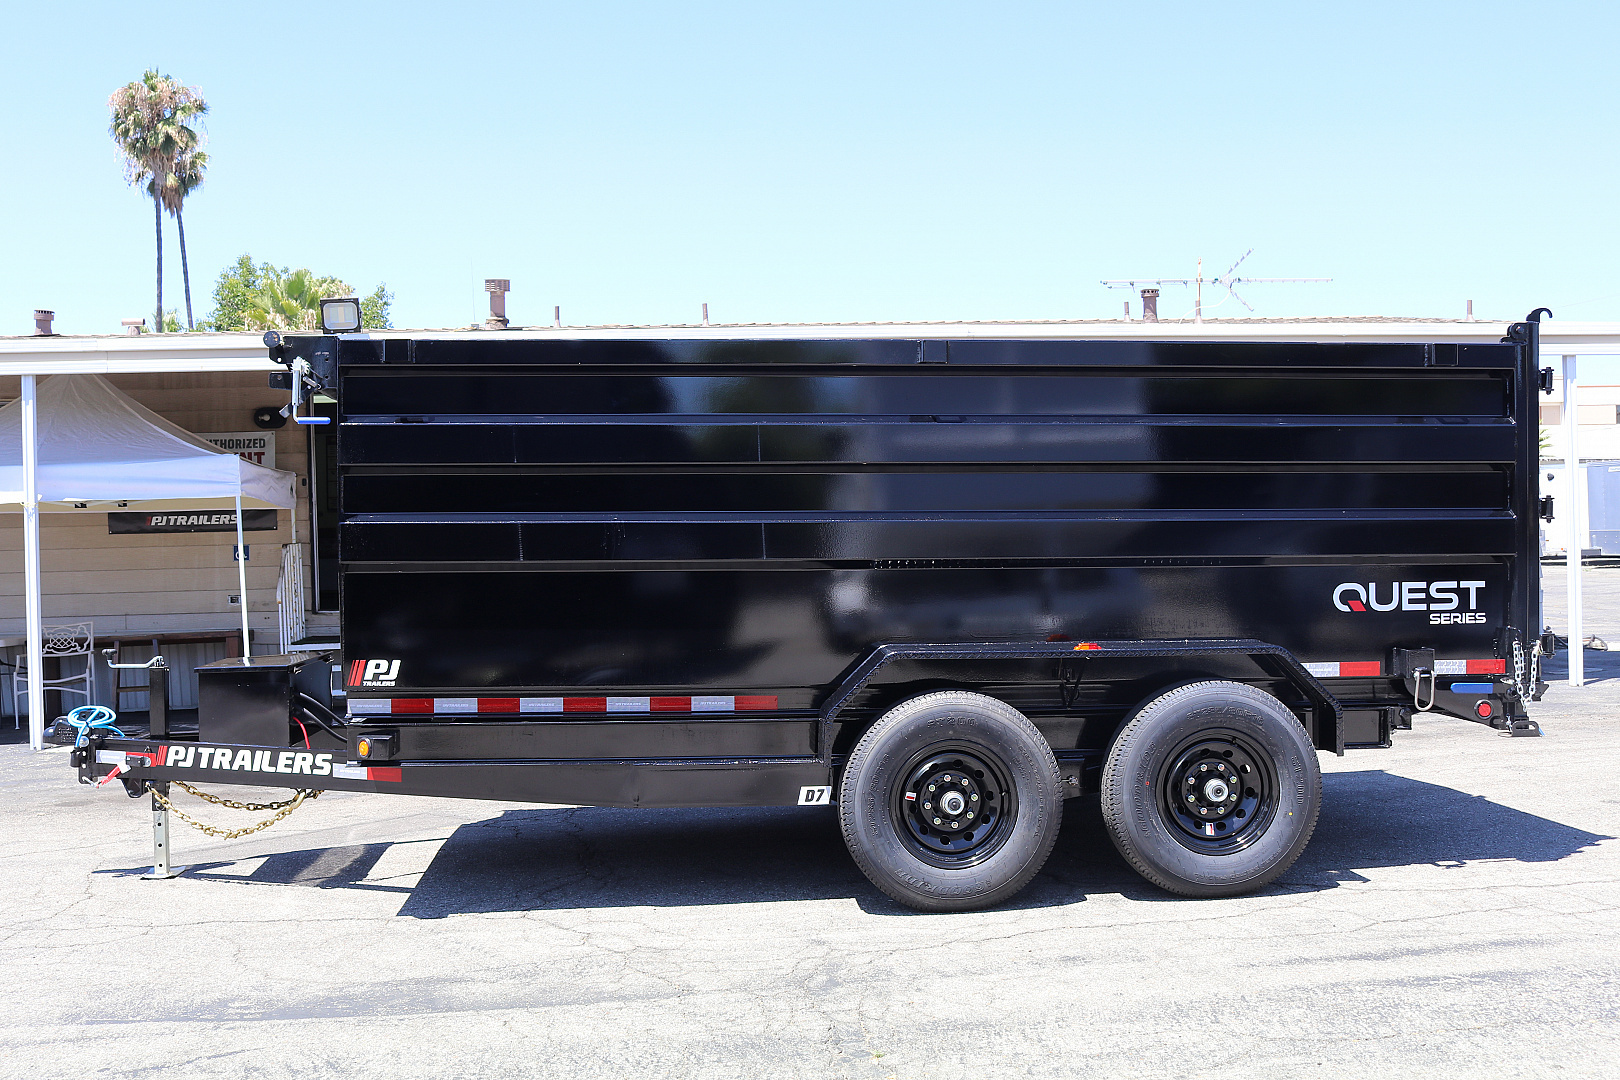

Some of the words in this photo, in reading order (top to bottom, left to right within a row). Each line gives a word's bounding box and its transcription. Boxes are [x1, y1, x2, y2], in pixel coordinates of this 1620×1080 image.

[1332, 580, 1486, 612] QUEST
[1429, 612, 1487, 625] SERIES
[363, 659, 402, 681] PJ
[804, 788, 826, 803] D7
